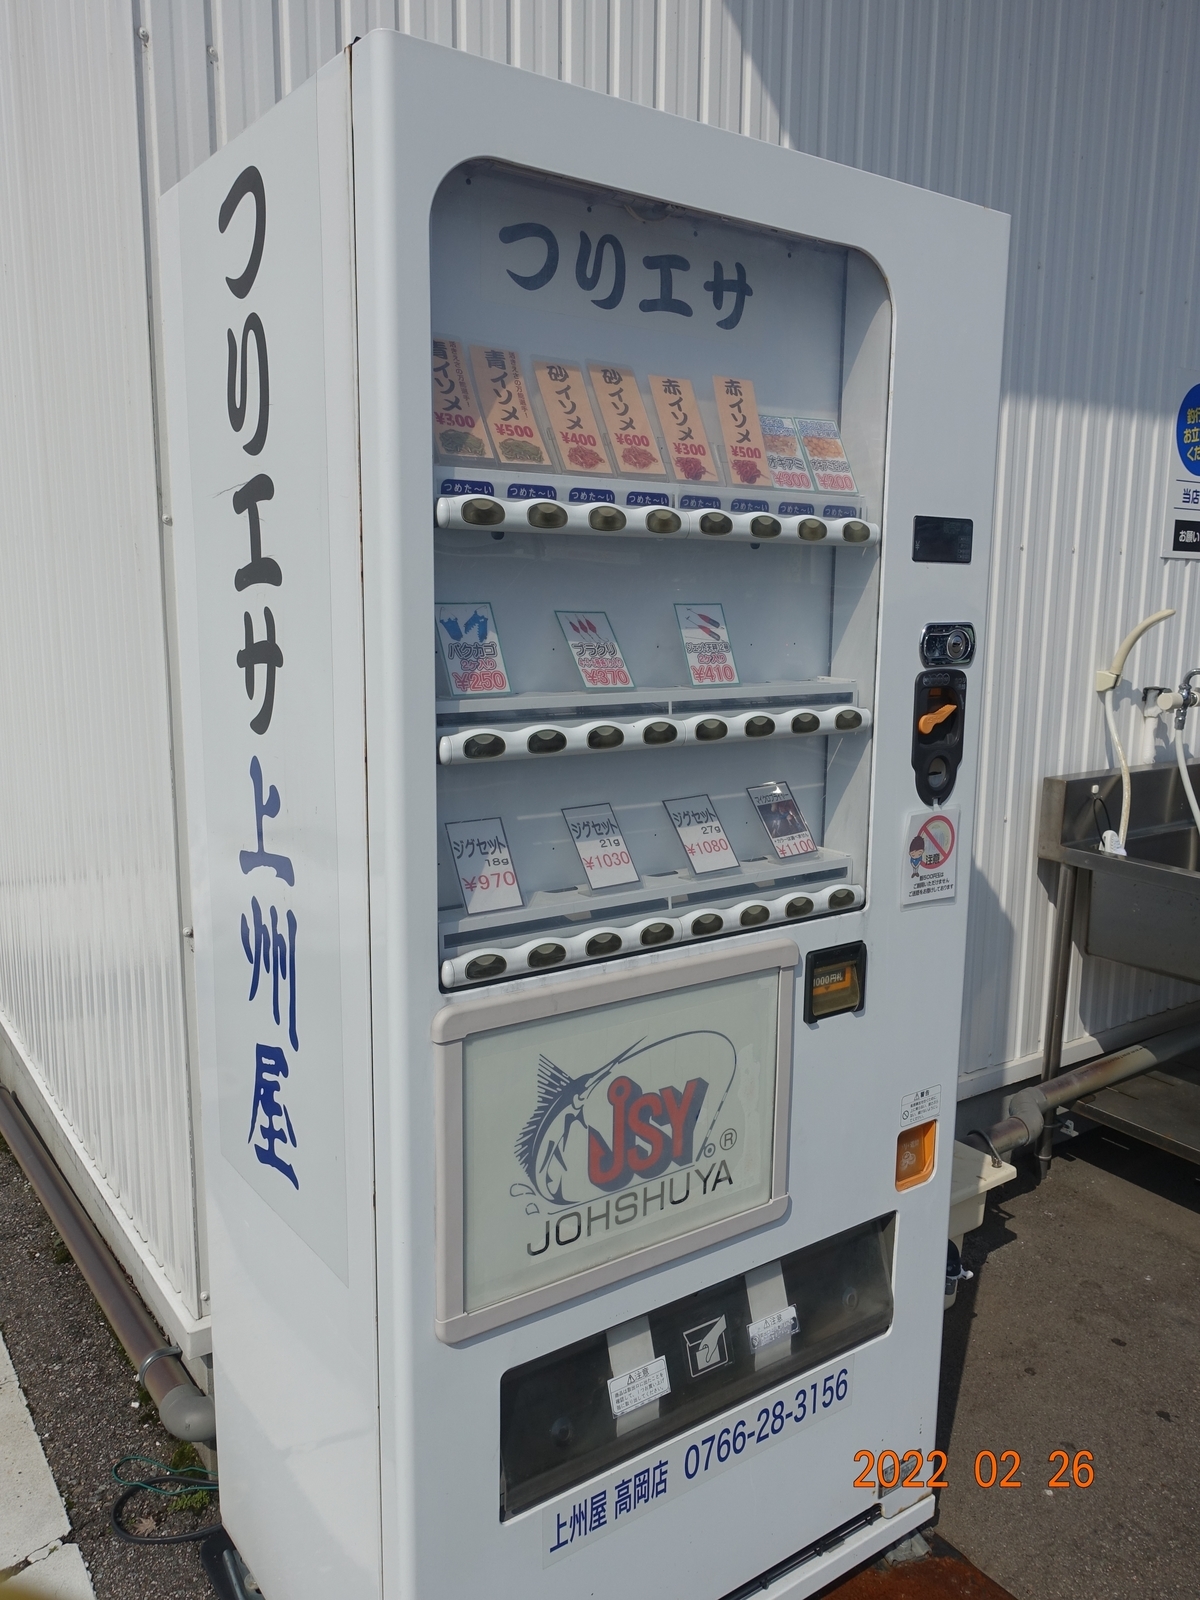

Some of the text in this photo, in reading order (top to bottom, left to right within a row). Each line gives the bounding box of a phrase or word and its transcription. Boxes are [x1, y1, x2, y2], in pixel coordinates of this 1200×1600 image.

[499, 222, 753, 330] つりエサ
[484, 350, 520, 422] 青イソメ
[546, 365, 584, 430] 砂イソメ
[601, 368, 636, 431] 砂イソメ
[662, 378, 695, 441] 赤イソメ
[724, 379, 752, 443] 赤イソメ
[434, 412, 475, 429] ¥300
[494, 423, 534, 438] ¥500
[559, 431, 597, 446] ¥400
[614, 433, 650, 447] ¥600
[218, 165, 283, 735] つりエサ
[673, 442, 706, 456] ¥300
[730, 445, 762, 459] ¥500
[770, 470, 811, 489] ¥300
[815, 472, 855, 491] ¥200
[452, 671, 506, 692] ¥250
[582, 668, 630, 686] ¥370
[691, 665, 735, 683] ¥410
[673, 808, 716, 828] ジグセット
[570, 818, 618, 839] ジグセット
[701, 825, 721, 834] 27g
[453, 836, 505, 859] ジグセット
[599, 839, 620, 848] 21g
[685, 838, 729, 856] ¥1080
[776, 839, 815, 857] ¥1100
[485, 858, 509, 867] 18g
[582, 851, 630, 870] ¥1030
[462, 871, 515, 892] ¥970
[239, 755, 299, 1190] 上州屋
[526, 1159, 733, 1257] JOHSHUYA
[550, 1489, 607, 1553] 上州屋
[614, 1459, 669, 1519] 高岡店
[684, 1368, 849, 1479] 0766-28-3156
